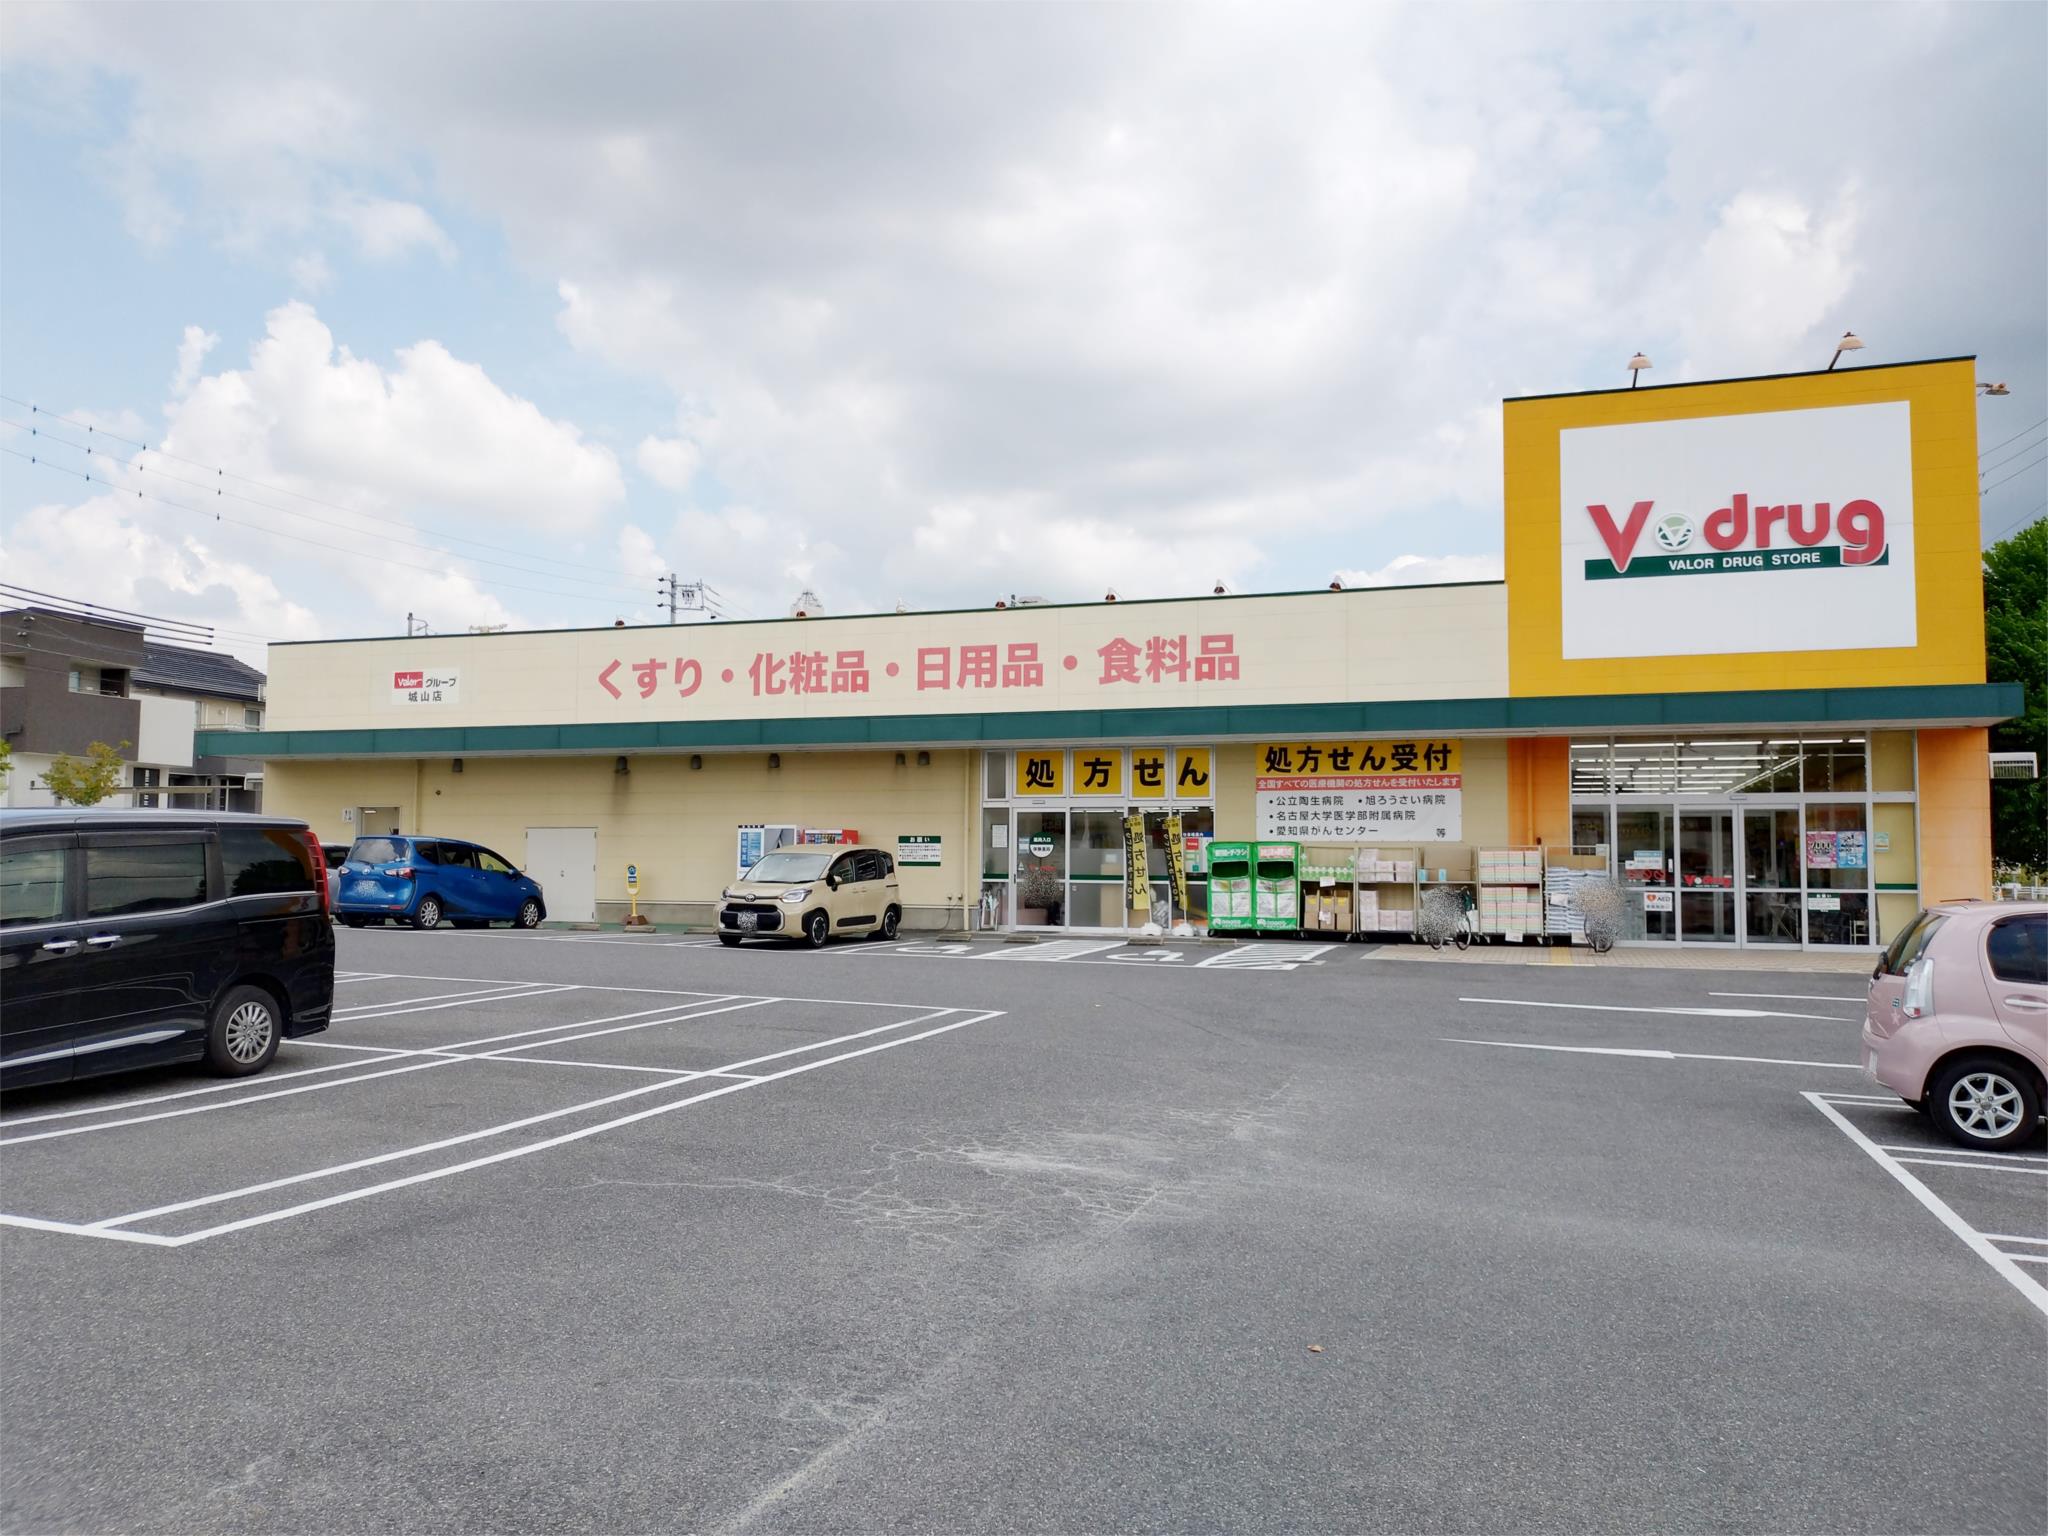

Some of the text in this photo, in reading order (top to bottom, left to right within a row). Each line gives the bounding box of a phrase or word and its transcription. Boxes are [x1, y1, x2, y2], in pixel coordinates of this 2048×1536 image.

[1668, 551, 1822, 571] VALOR DRUG STORE
[425, 677, 457, 688] グループ
[408, 690, 442, 702] 城山店
[1265, 743, 1452, 773] 処方せん受付
[1025, 757, 1209, 788] 処方せん
[1436, 828, 1446, 838] 等
